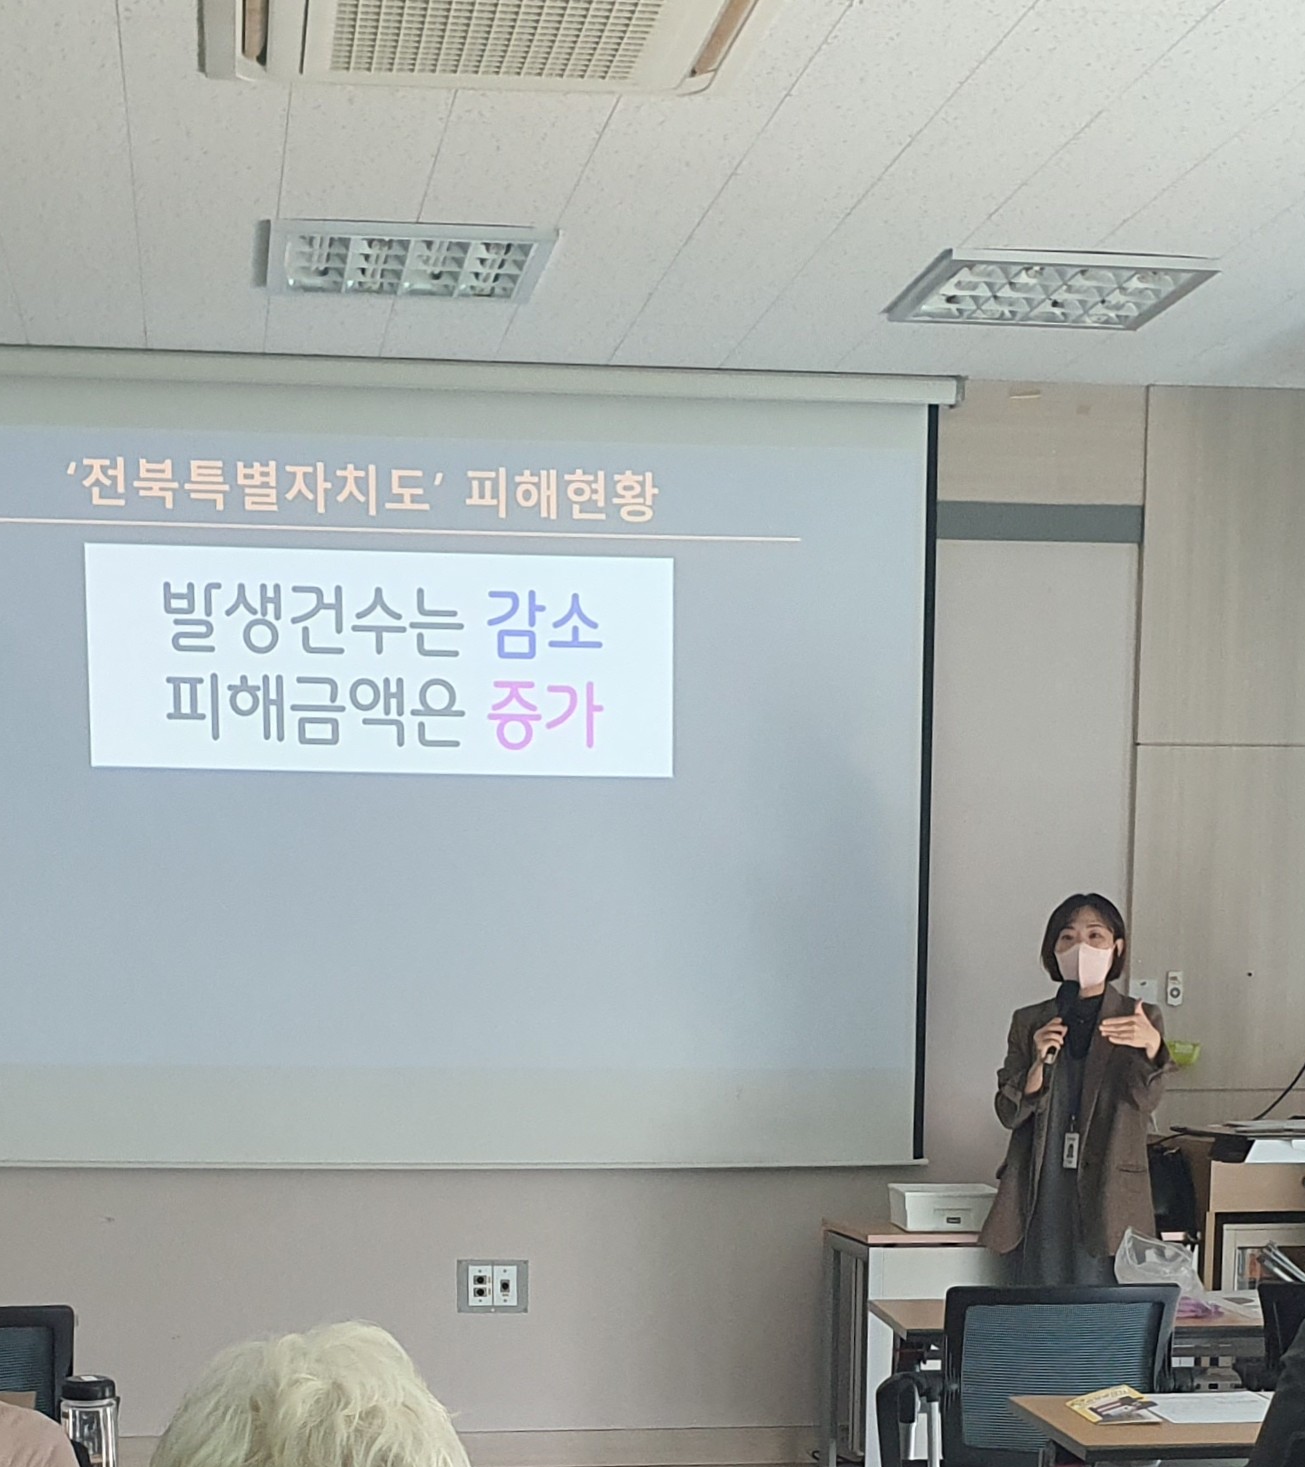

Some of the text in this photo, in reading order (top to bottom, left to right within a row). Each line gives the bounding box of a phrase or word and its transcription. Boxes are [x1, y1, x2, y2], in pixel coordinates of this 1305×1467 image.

[465, 466, 659, 524] 피해현황
[162, 581, 604, 660] 발생건수는 감소
[165, 672, 604, 750] 피해금액은 증가
